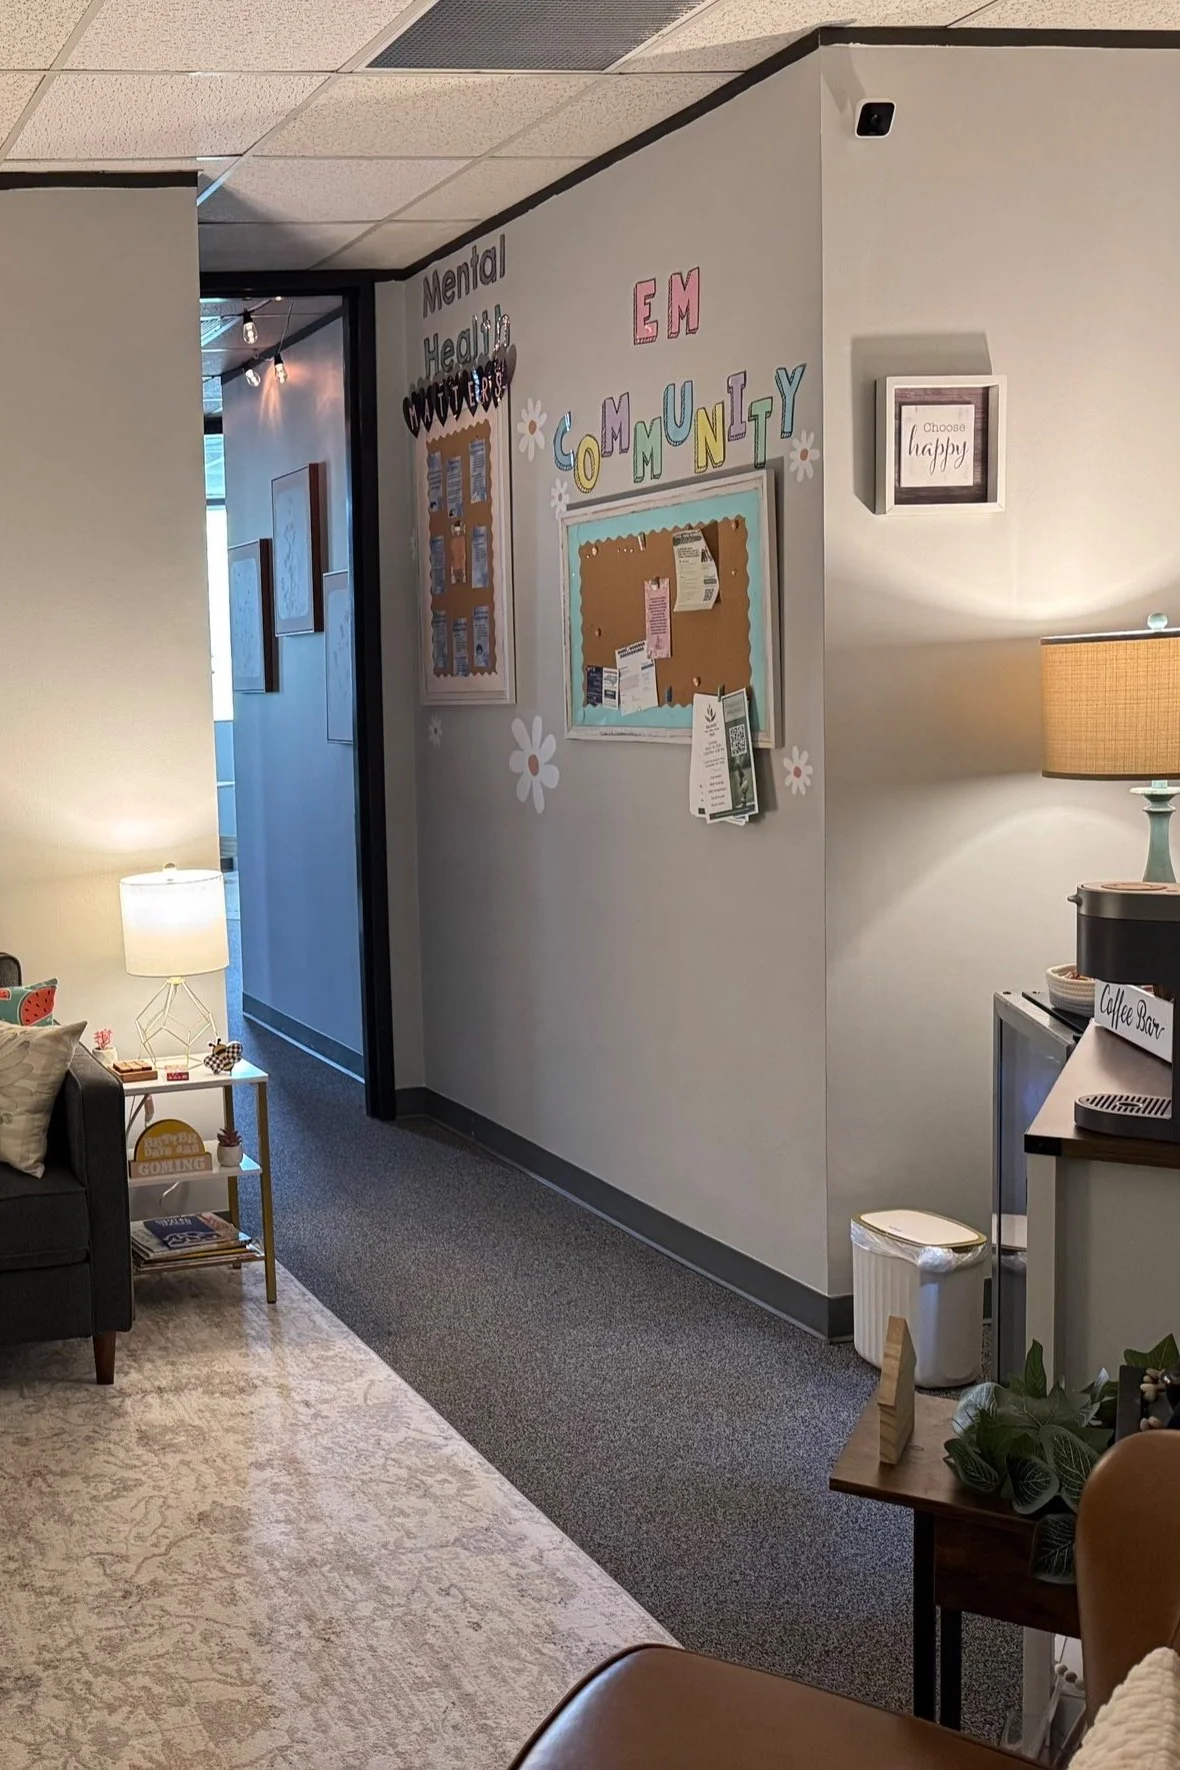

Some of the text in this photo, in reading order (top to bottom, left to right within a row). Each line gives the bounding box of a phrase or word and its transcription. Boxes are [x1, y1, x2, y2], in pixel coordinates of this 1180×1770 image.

[423, 233, 506, 318] Mental
[633, 266, 700, 345] EM
[423, 304, 511, 379] Health
[408, 371, 504, 430] MATTERS
[553, 363, 807, 493] COMMUNITY
[922, 422, 966, 433] Choose
[908, 424, 970, 475] happy
[1100, 983, 1165, 1040] Coffee Bar
[139, 1157, 206, 1176] COMING
